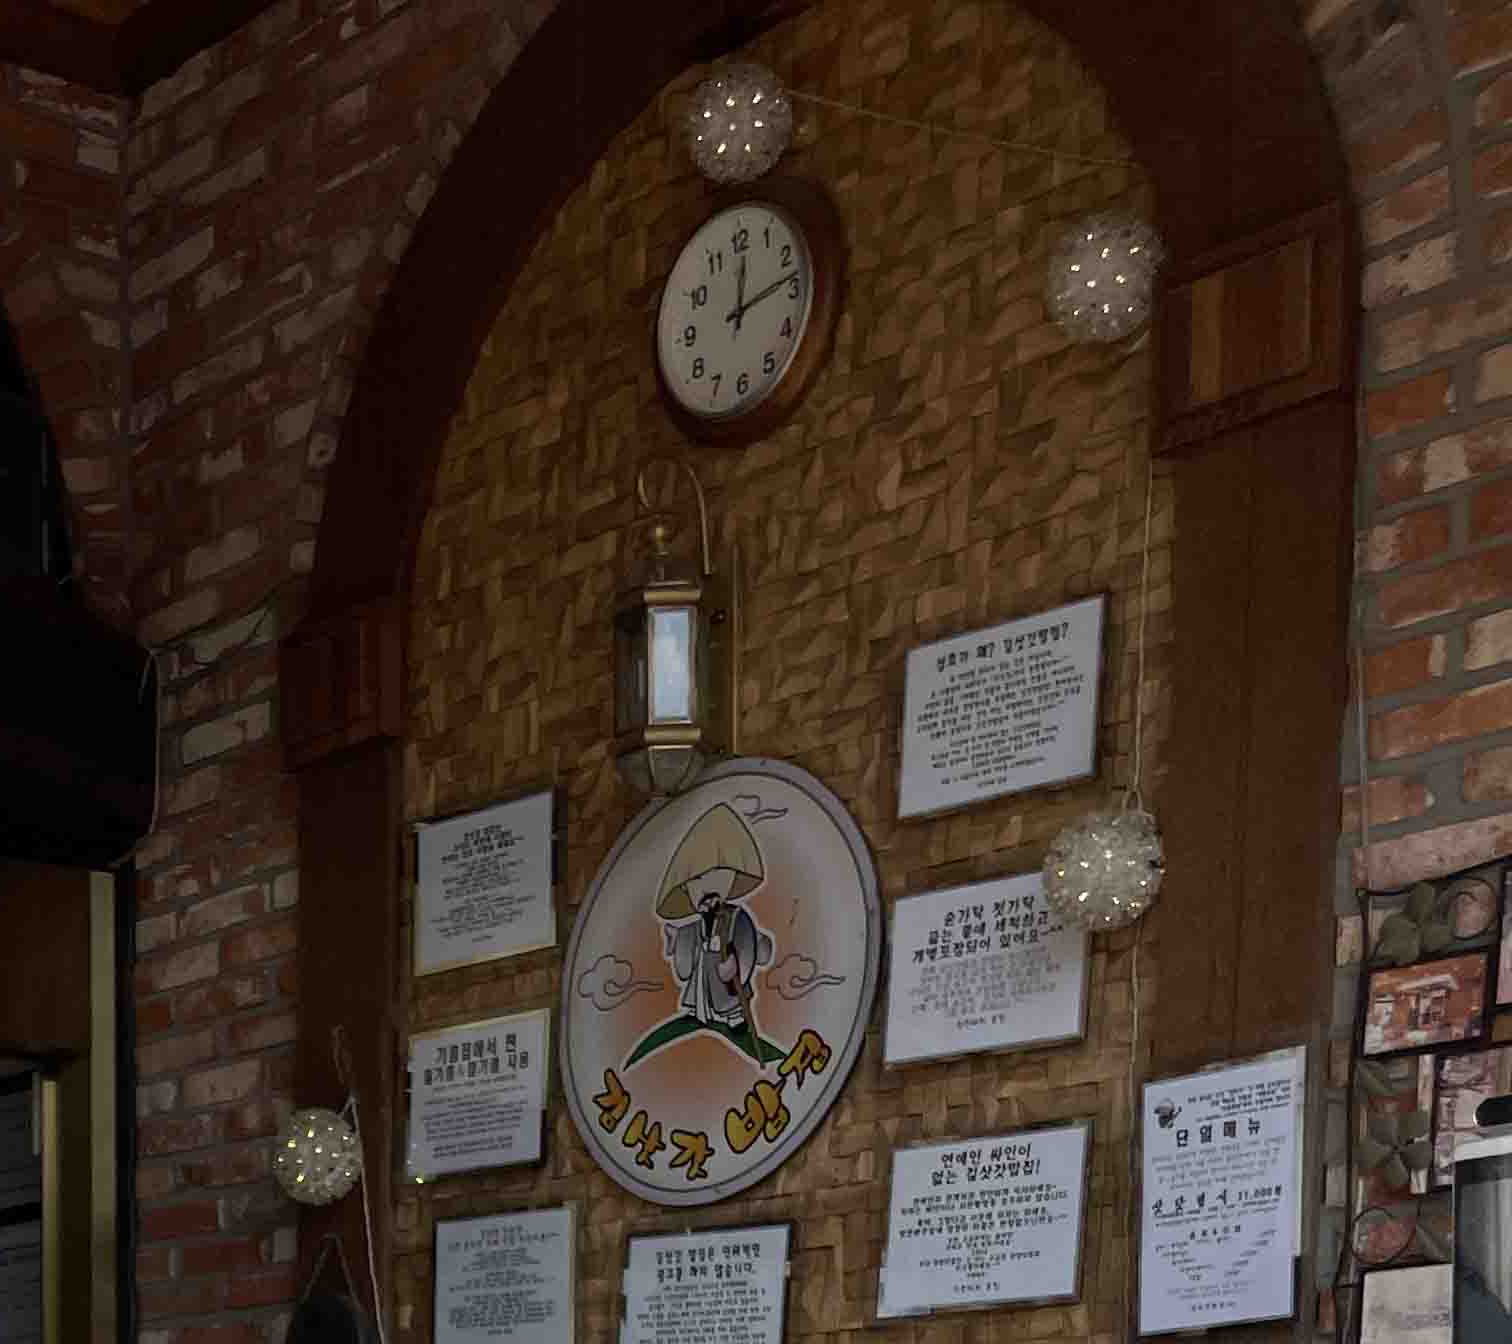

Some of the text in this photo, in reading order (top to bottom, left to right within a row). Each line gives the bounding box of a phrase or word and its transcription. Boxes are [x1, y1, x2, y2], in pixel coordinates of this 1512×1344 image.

[731, 228, 750, 254] 12
[763, 227, 771, 249] 1
[707, 251, 724, 276] 11
[780, 245, 793, 268] 2
[690, 284, 708, 311] 10
[788, 277, 800, 300] 3
[683, 325, 697, 347] 9
[779, 317, 793, 340] 4
[692, 357, 705, 379] 8
[763, 351, 776, 375] 5
[712, 373, 723, 398] 7
[736, 373, 750, 395] 6
[941, 1148, 982, 1168] 연예인
